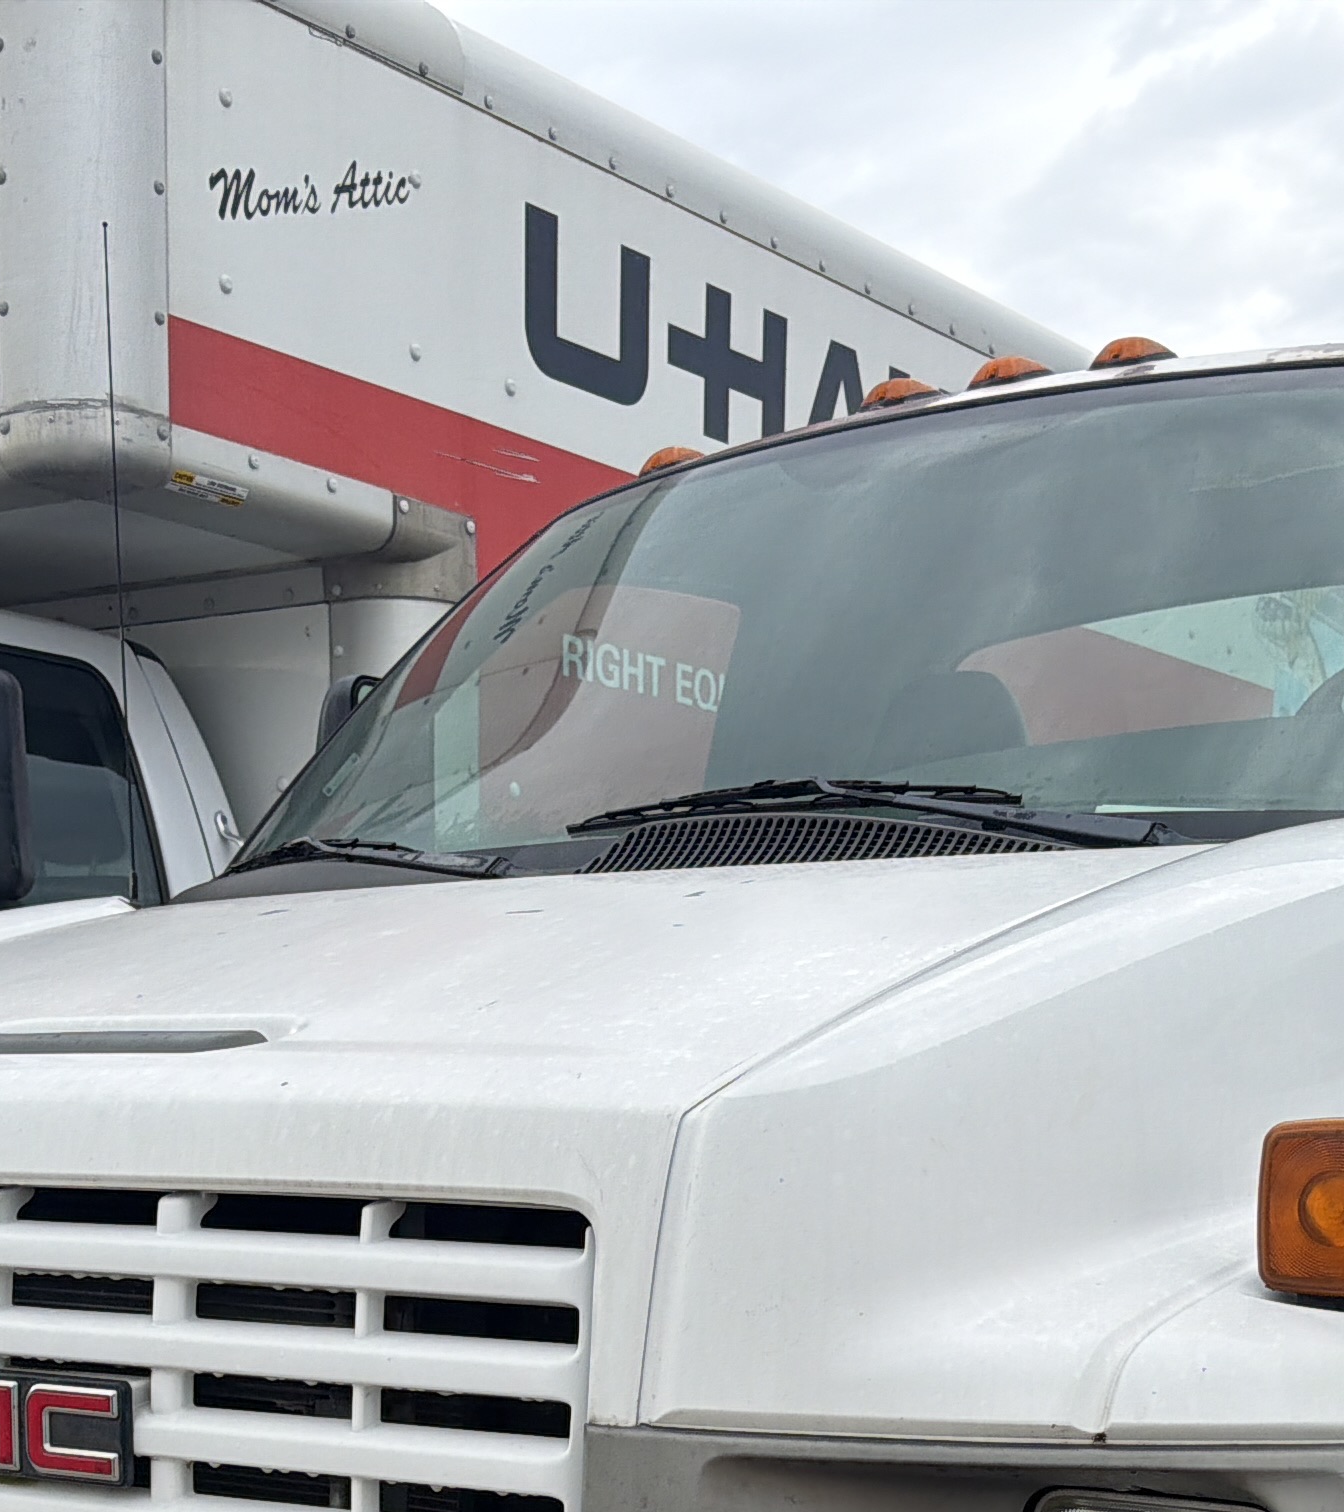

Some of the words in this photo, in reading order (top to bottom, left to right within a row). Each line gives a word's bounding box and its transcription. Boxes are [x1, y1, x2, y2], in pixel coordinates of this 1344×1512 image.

[209, 167, 321, 220] Mom's
[330, 160, 410, 214] Attic
[525, 201, 912, 444] U-HA
[562, 632, 666, 697] RIGHT
